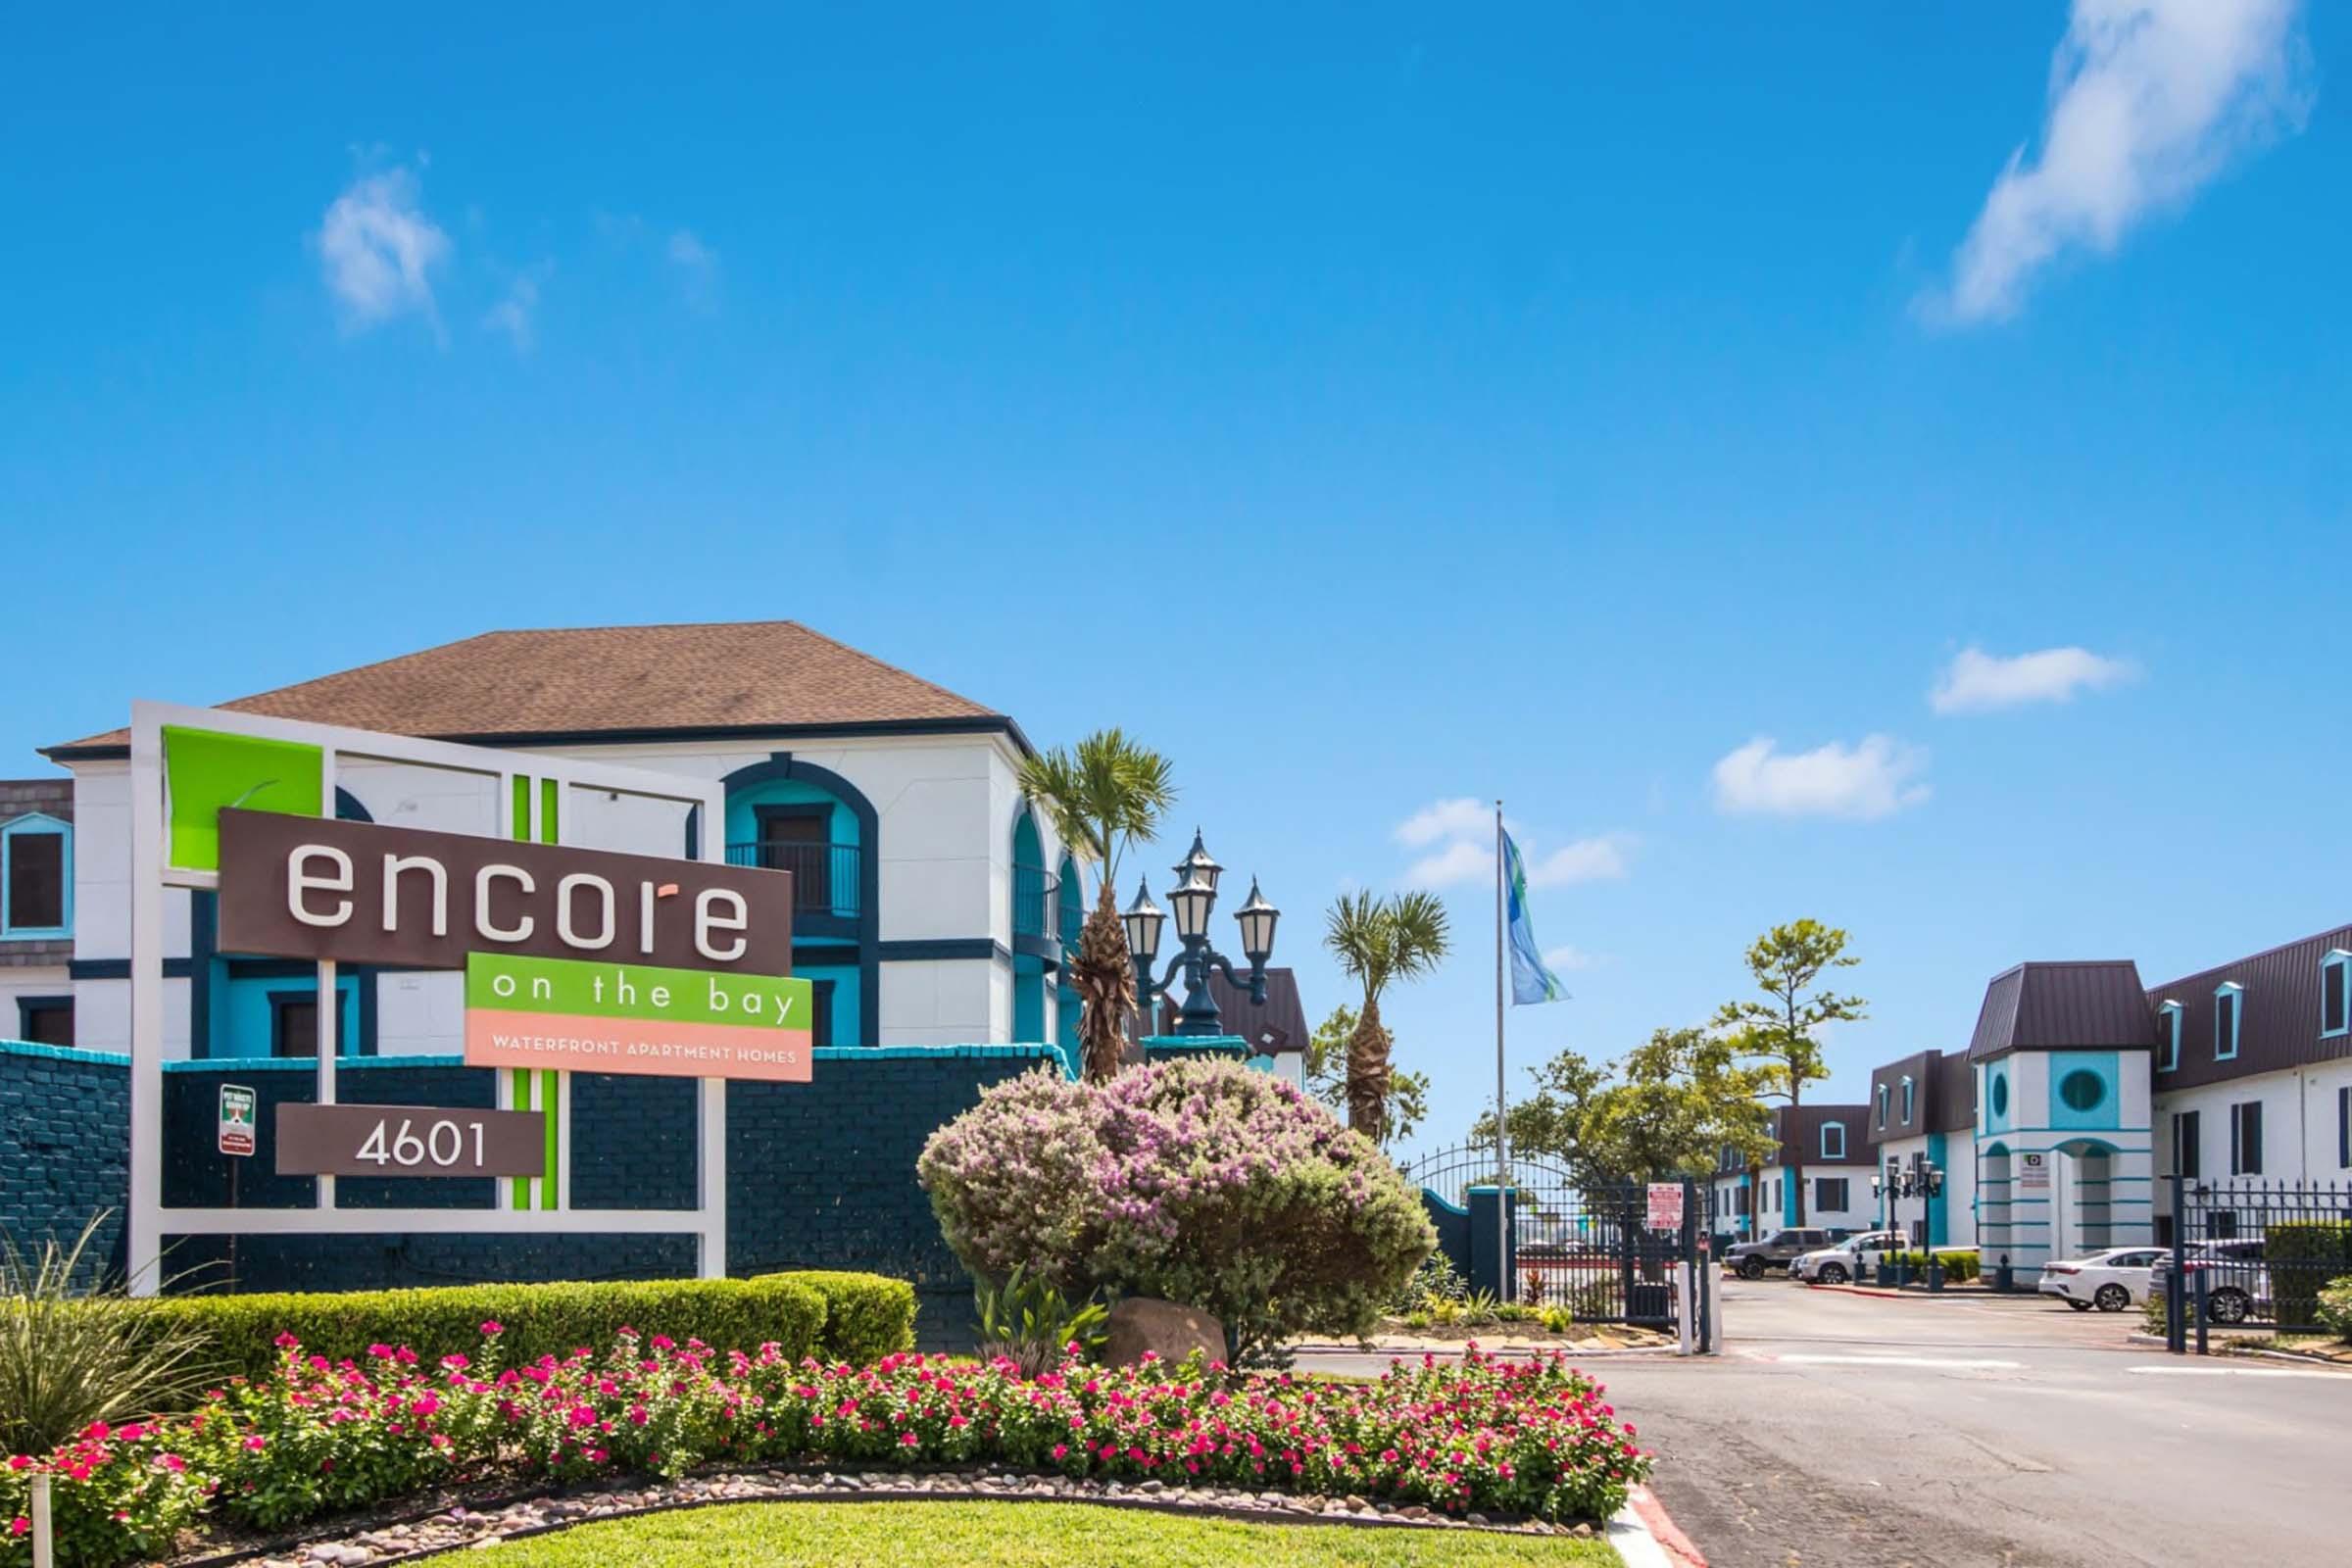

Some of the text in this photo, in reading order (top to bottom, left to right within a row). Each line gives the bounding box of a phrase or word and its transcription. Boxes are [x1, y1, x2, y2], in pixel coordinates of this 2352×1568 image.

[288, 844, 748, 960] encore
[493, 970, 793, 1025] on the bay
[493, 1035, 796, 1063] WATERFRONT APARTMENT HOMES
[356, 1119, 484, 1166] 4601
